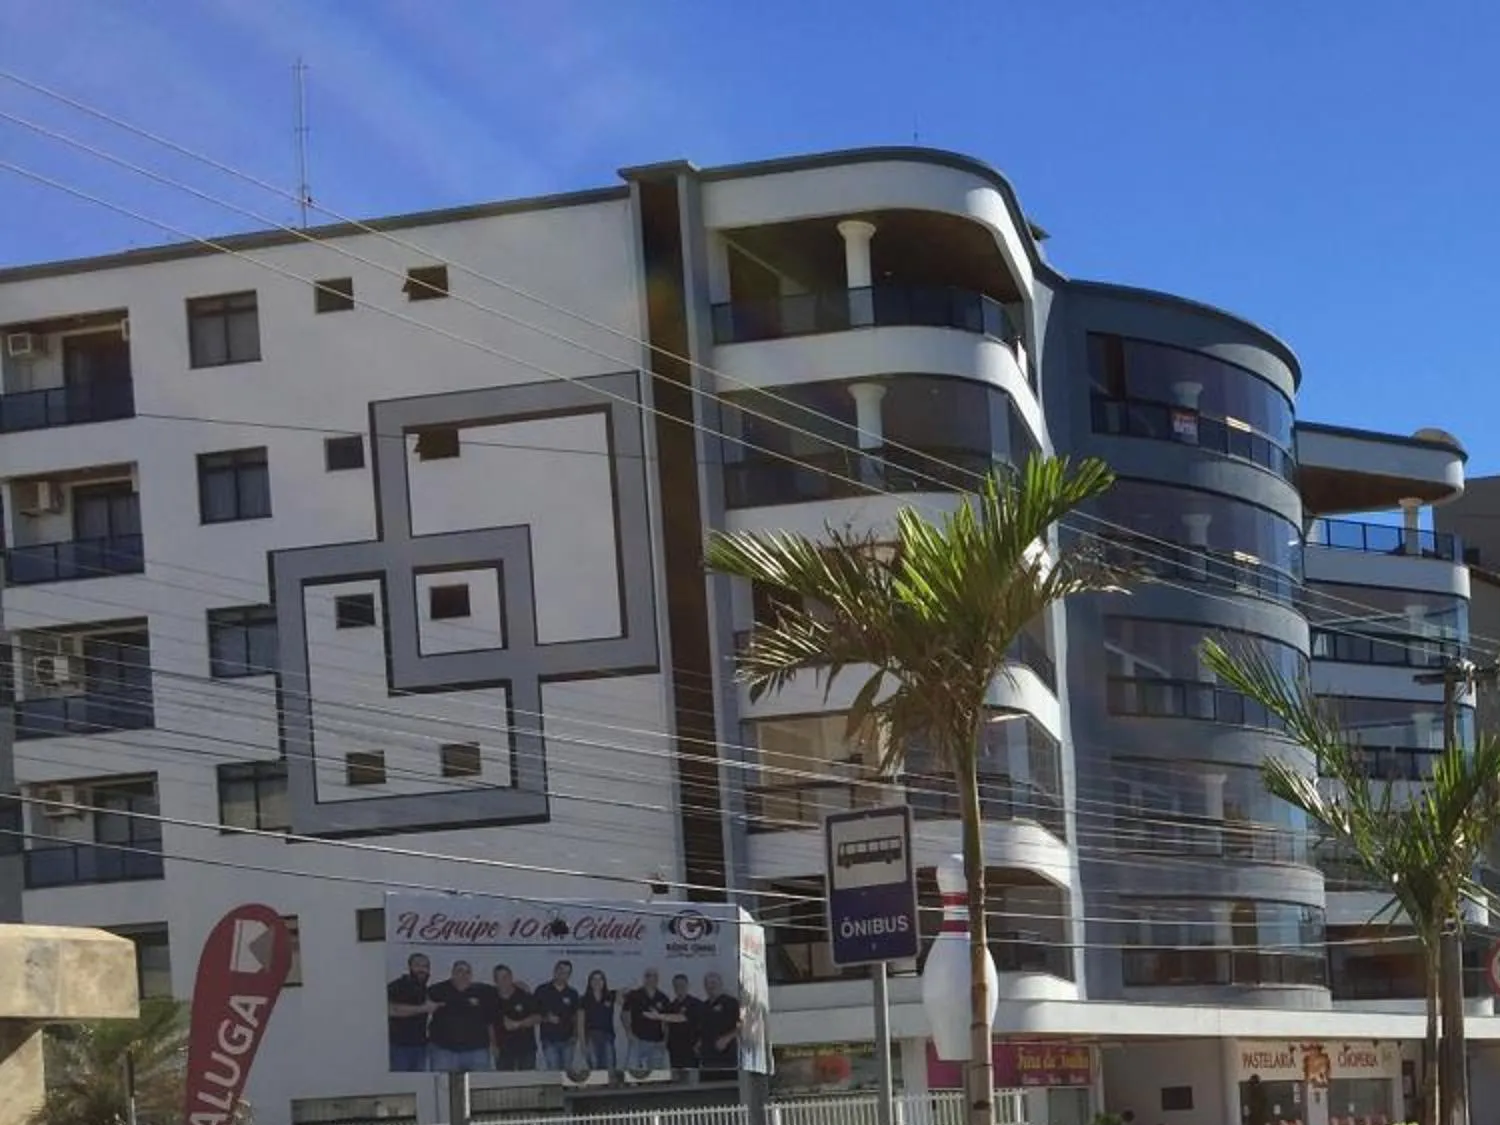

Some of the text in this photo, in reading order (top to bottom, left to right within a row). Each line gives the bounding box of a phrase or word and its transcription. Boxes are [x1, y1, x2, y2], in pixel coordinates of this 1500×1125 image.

[396, 911, 419, 939] A
[420, 913, 499, 942] Equipe
[509, 917, 539, 938] 10
[573, 915, 646, 941] Cidade
[840, 915, 909, 939] ÔNIBUS
[1242, 1051, 1297, 1069] PASTELARIA
